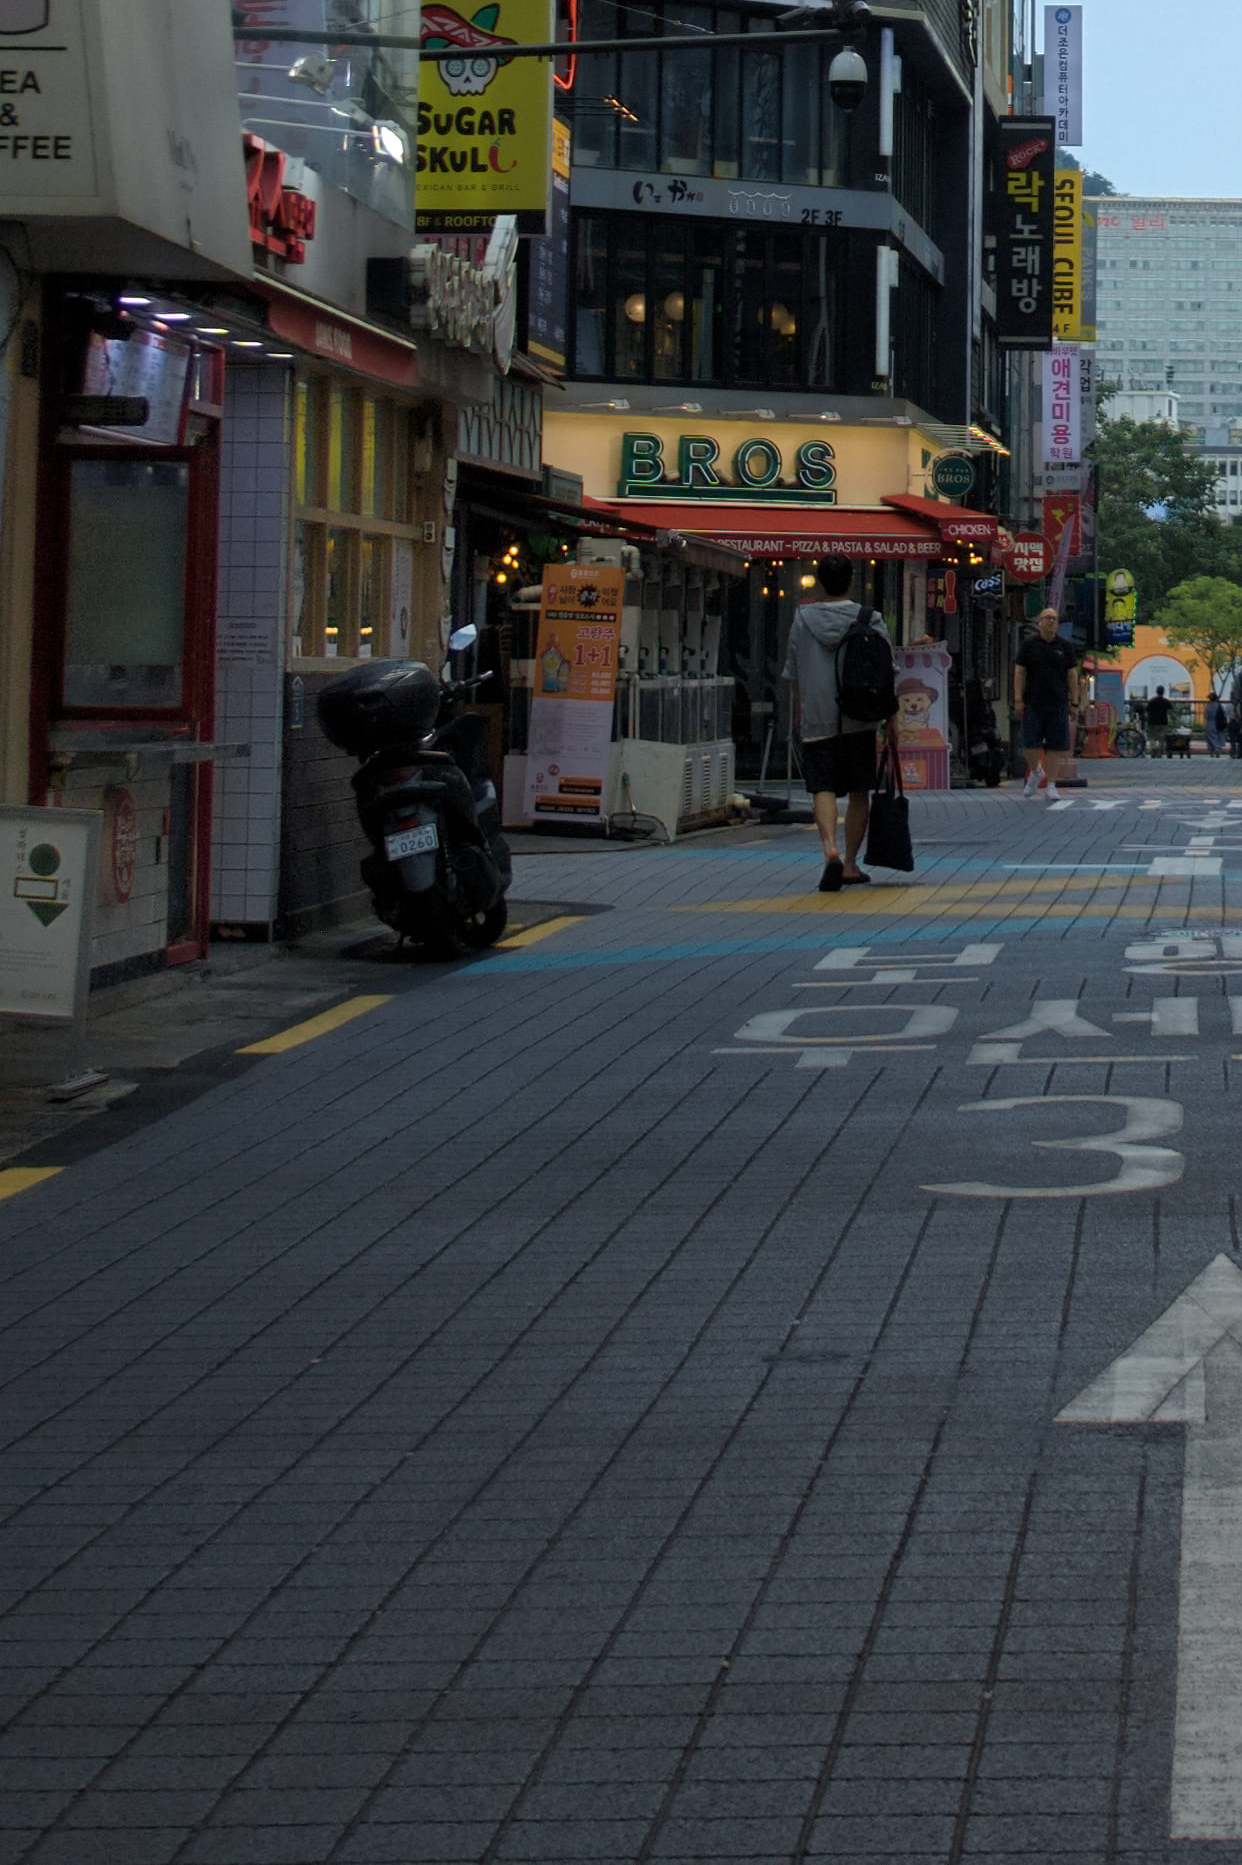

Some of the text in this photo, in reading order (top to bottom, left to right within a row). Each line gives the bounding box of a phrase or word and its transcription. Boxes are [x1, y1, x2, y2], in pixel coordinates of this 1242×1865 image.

[414, 182, 454, 192] EXICAN
[1051, 358, 1072, 445] 애견미용
[621, 431, 838, 487] BROS
[1049, 446, 1073, 459] 학원
[936, 474, 971, 484] BROS
[792, 540, 821, 552] PIZZA
[831, 540, 863, 553] PASTA
[873, 541, 908, 553] SALAD
[917, 542, 942, 554] BEER
[574, 643, 614, 668] 1+1
[400, 835, 434, 853] 0260
